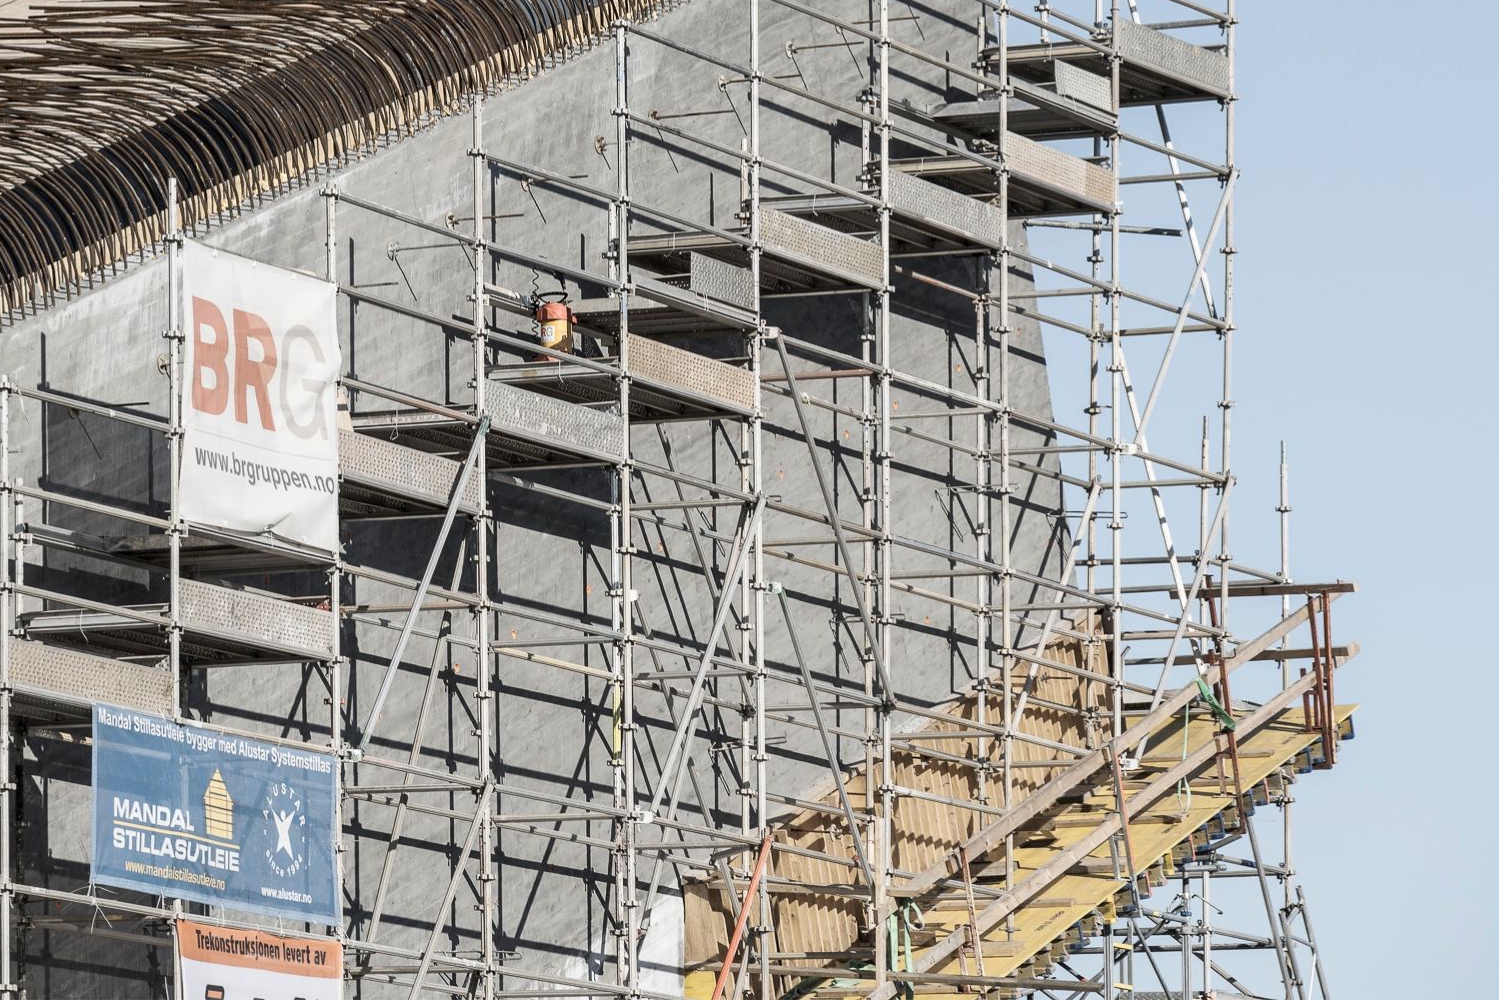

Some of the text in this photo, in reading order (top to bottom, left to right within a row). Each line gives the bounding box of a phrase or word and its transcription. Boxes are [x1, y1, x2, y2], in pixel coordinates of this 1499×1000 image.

[191, 295, 329, 441] BRG
[194, 446, 335, 495] www.brgruppen.no
[98, 707, 331, 773] Mandal Stillasutleie bygger med Alustar Systemstillas
[113, 796, 195, 832] MANDAL
[262, 783, 306, 827] ALUSTAR
[112, 827, 240, 873] STILLASUTLEIE
[260, 886, 312, 904] www.alustar.no
[195, 929, 327, 966] Trekonstruksjonen levert av
